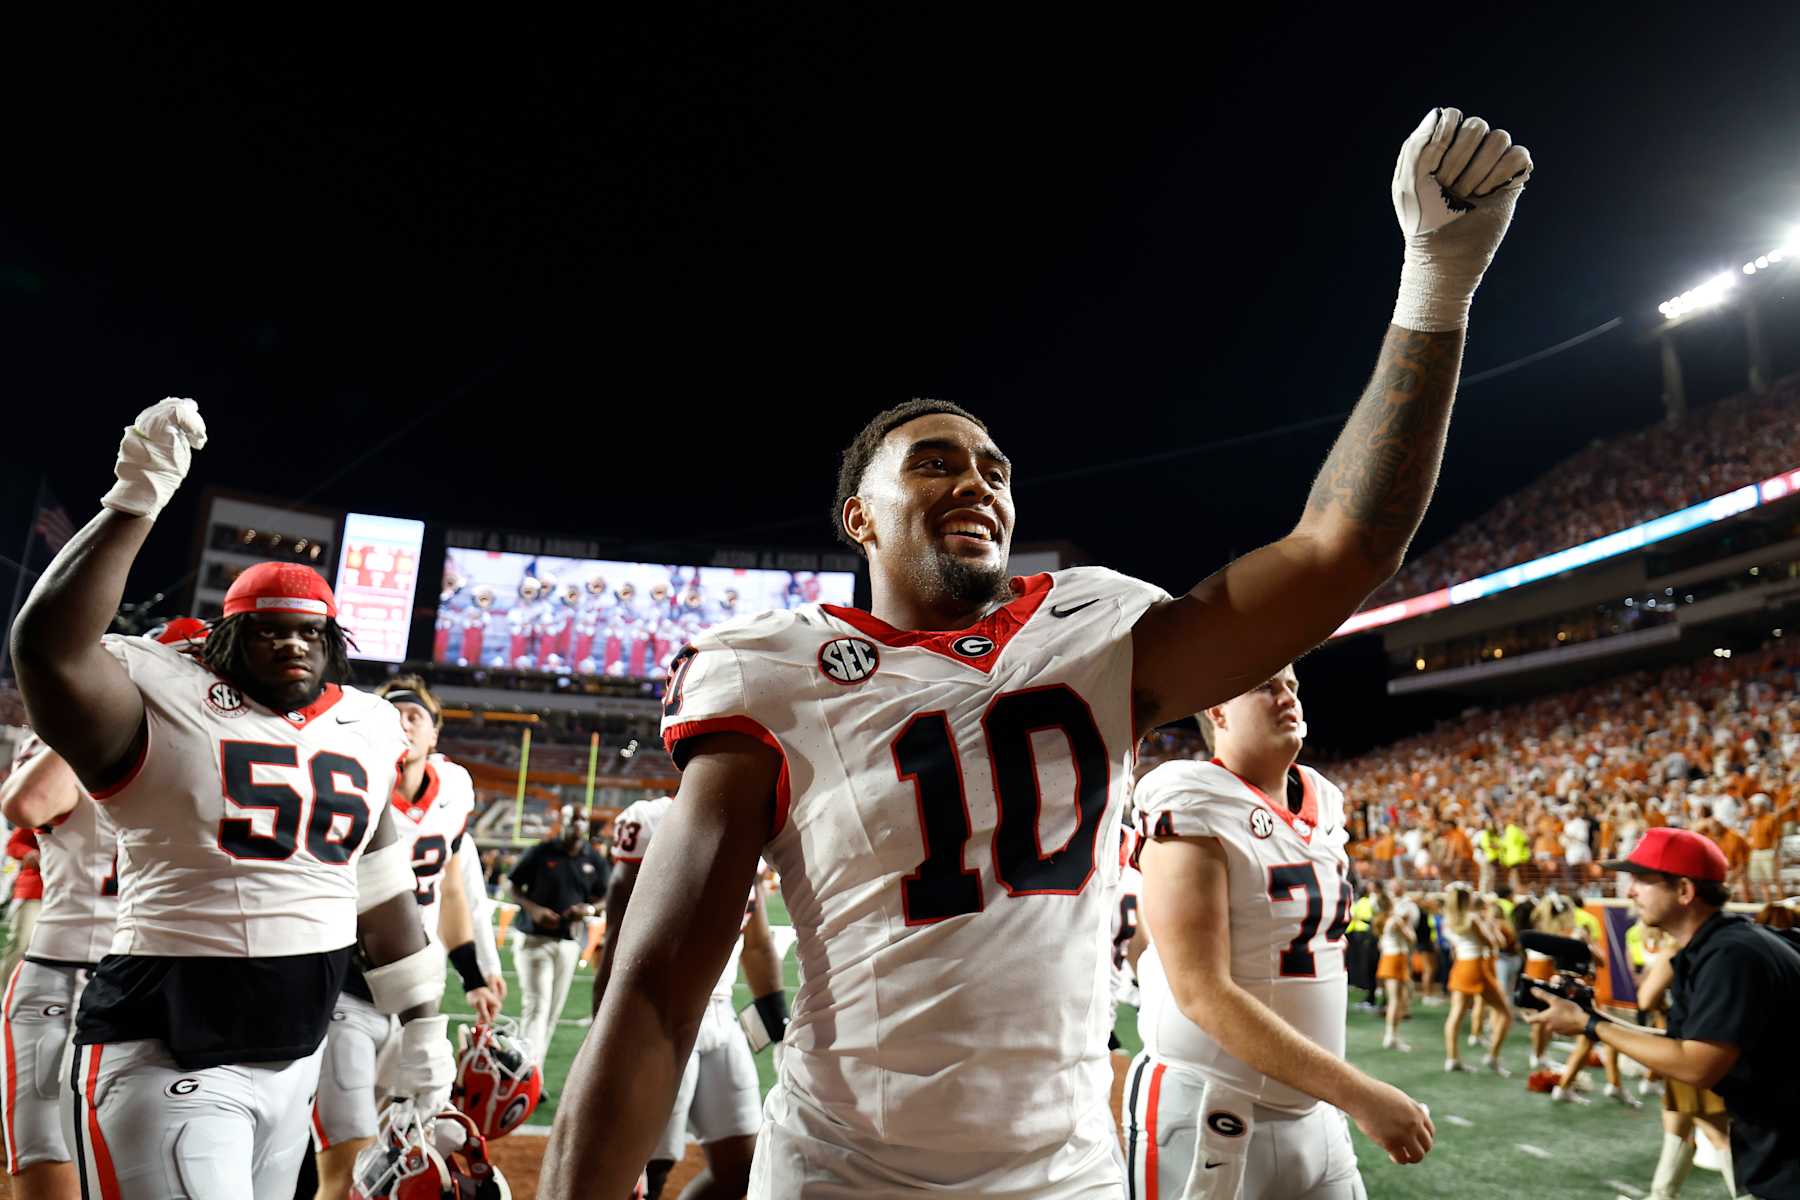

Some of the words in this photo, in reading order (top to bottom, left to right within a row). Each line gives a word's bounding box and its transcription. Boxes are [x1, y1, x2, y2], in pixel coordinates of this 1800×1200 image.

[960, 637, 993, 654] G
[822, 639, 876, 681] SEC
[211, 683, 240, 710] SEC
[217, 739, 371, 866] 56
[890, 683, 1110, 927] 10
[172, 1078, 199, 1095] G
[1213, 1114, 1244, 1134] G
